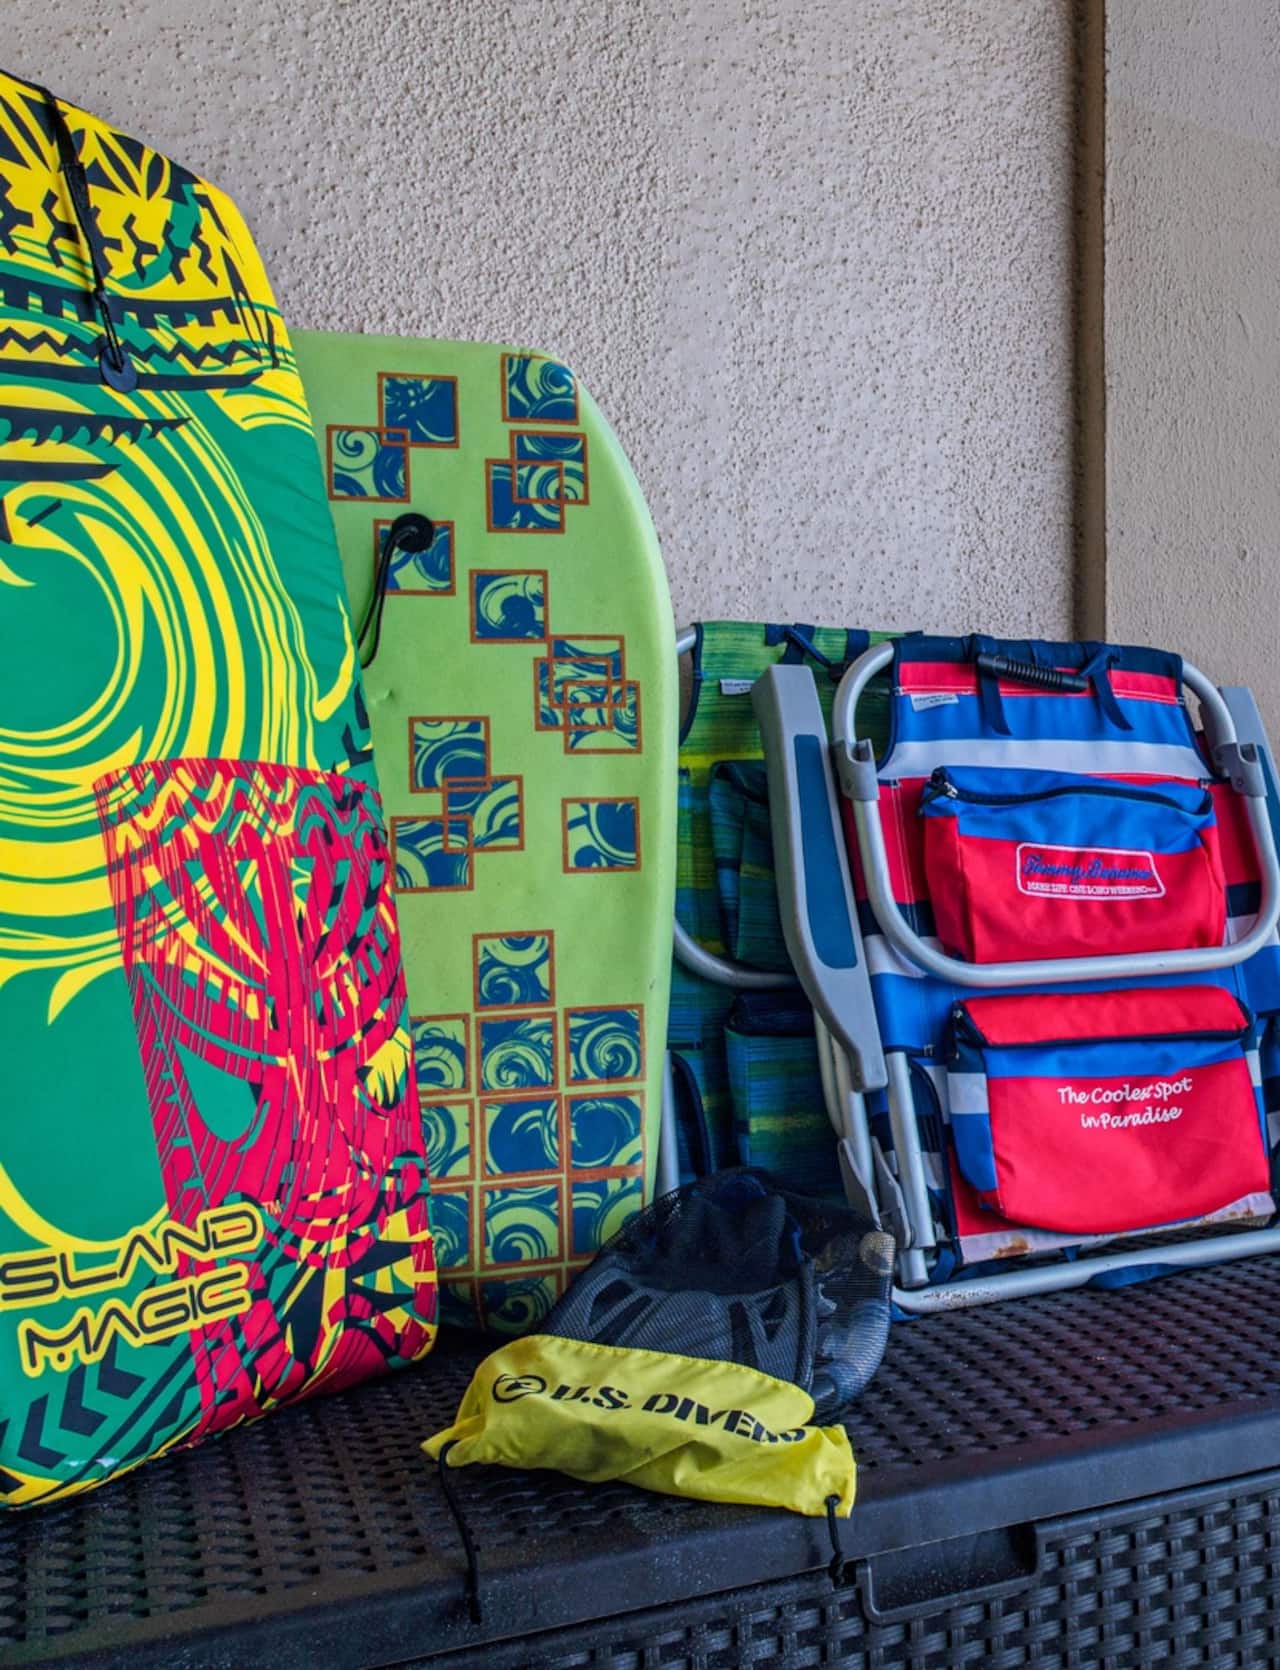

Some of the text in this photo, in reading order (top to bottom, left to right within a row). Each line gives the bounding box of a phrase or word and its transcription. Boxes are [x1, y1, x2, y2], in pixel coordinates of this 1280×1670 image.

[1057, 1077, 1193, 1105] The Coolest Spot
[1080, 1106, 1183, 1130] in Paradise
[22, 1268, 250, 1372] MAGIC
[549, 1384, 633, 1410] U.S.
